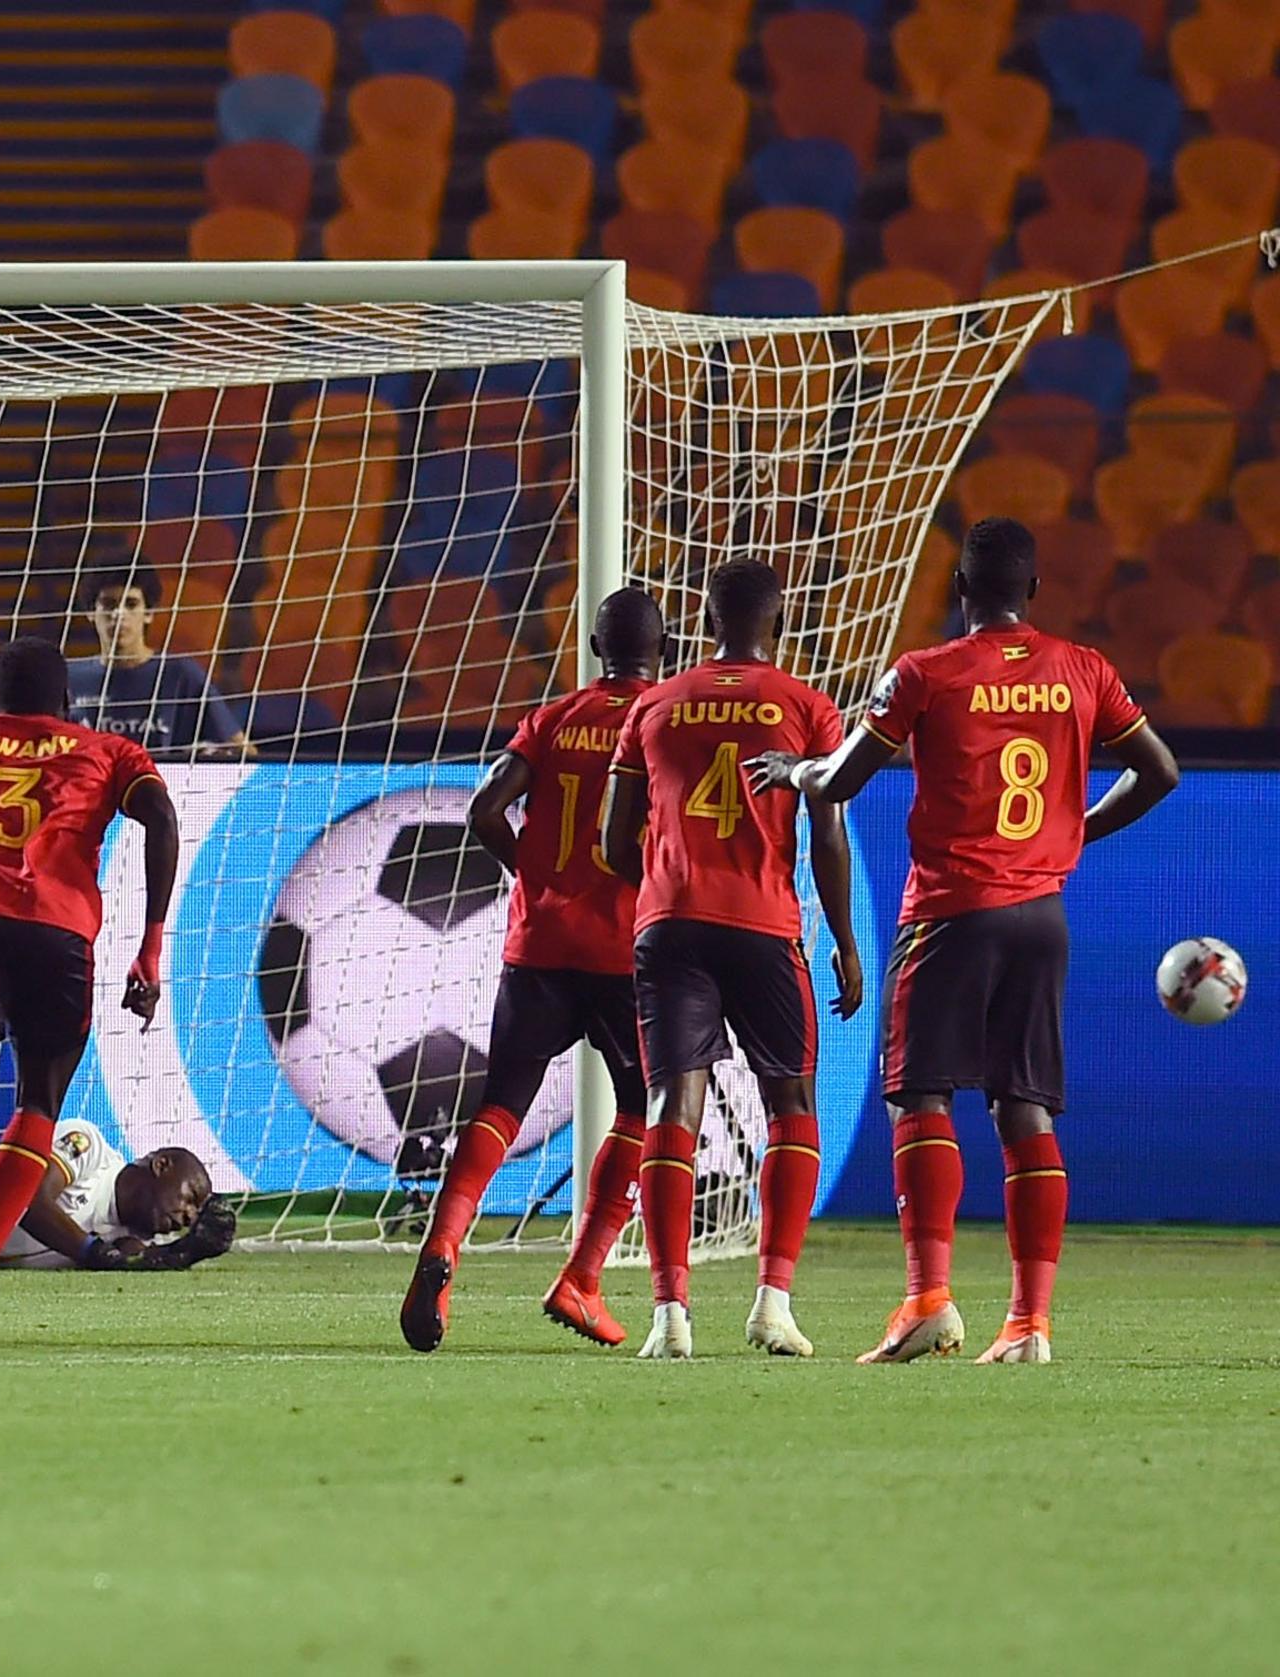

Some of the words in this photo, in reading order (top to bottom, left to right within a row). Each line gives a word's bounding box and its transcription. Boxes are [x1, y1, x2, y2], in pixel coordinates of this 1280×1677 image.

[969, 683, 1071, 713] AUCHO
[101, 716, 170, 734] TOTAL
[670, 701, 783, 728] JUUKO
[557, 725, 623, 752] WALU
[685, 742, 743, 840] 4
[996, 737, 1049, 841] 8
